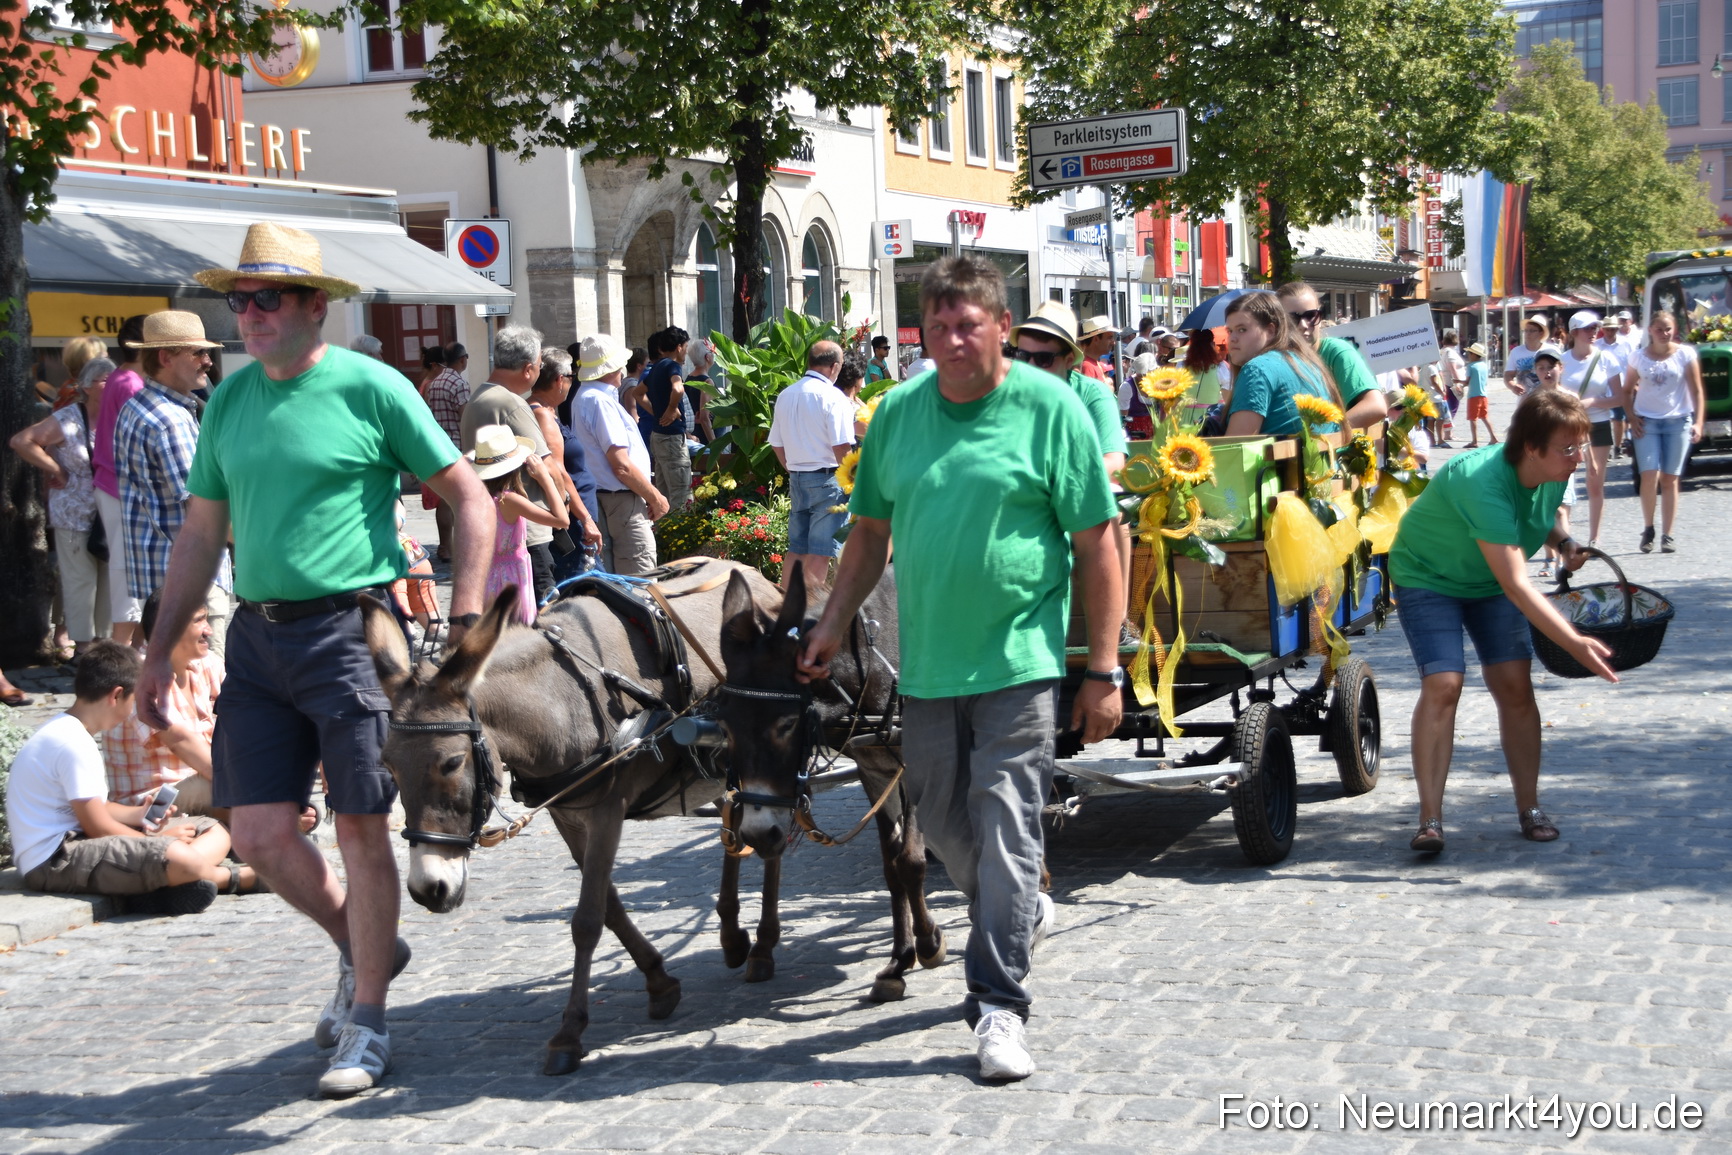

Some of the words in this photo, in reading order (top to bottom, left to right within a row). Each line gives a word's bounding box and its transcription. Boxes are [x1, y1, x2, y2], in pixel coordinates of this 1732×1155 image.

[78, 100, 312, 172] SCHLIERF
[1054, 123, 1152, 146] Parkleitsystem
[1090, 154, 1155, 171] Rosengasse
[1067, 212, 1103, 226] Rosengasse
[1366, 327, 1429, 346] Modelleisenbahnclub
[1370, 346, 1401, 358] Neumarkt
